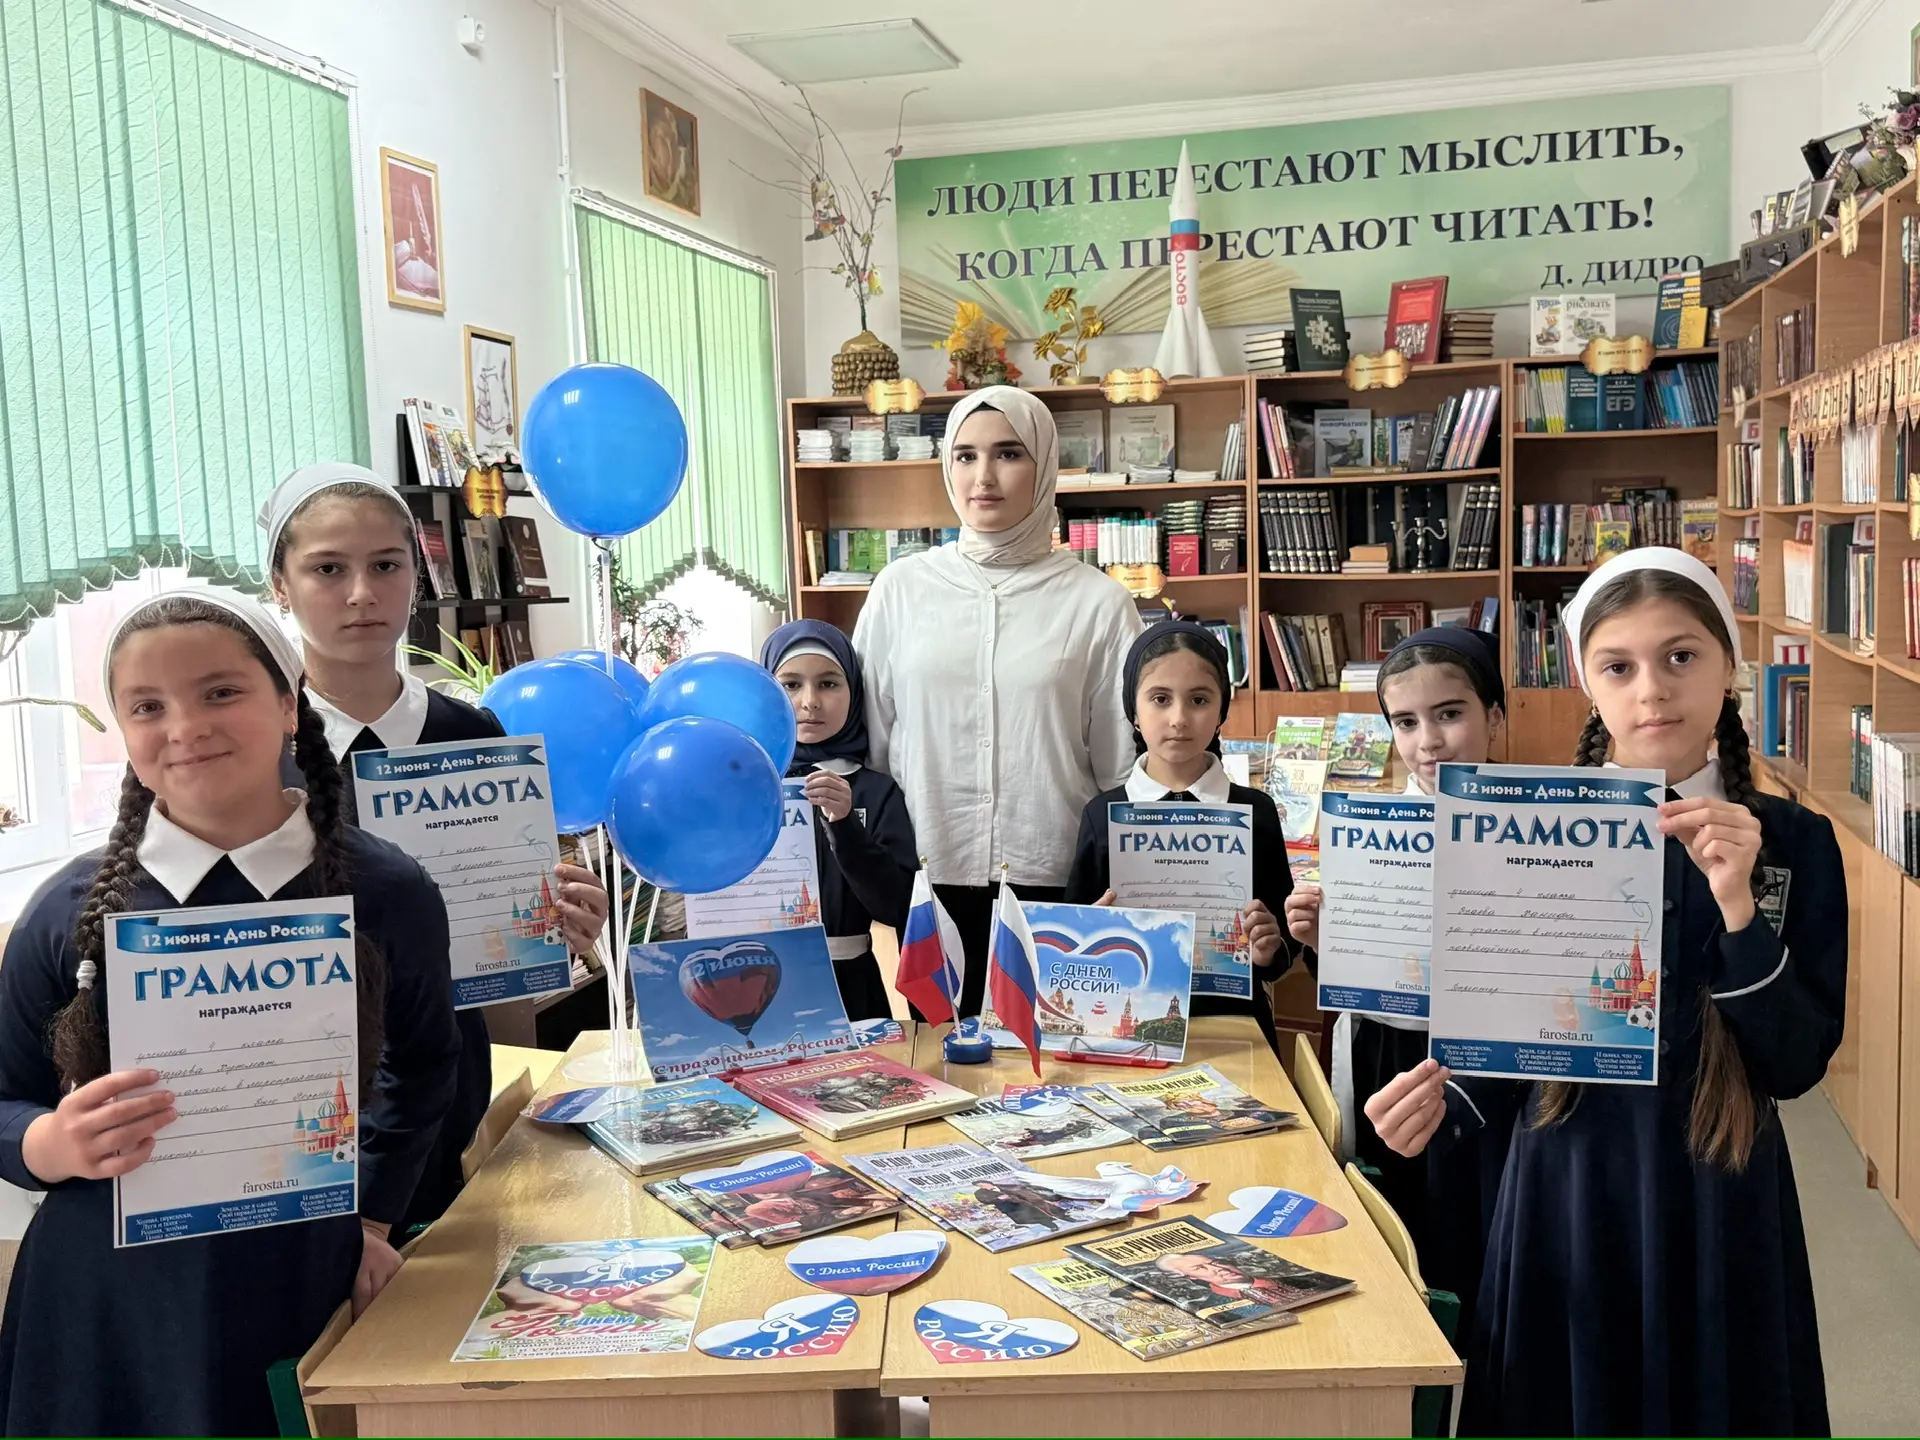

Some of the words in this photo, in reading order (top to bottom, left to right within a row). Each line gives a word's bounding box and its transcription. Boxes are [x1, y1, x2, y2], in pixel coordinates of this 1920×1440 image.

[927, 176, 1074, 217] ЛЮДИ
[1398, 124, 1684, 176] МЫСЛИТЬ,
[955, 241, 1109, 283] КОГДА
[1430, 196, 1654, 244] ЧИТАТЬ!
[1540, 264, 1573, 290] Д.
[375, 764, 391, 776] 12
[394, 761, 430, 774] июня
[441, 757, 474, 772] День
[477, 753, 518, 766] России
[372, 774, 545, 819] ГРАМОТА
[1461, 782, 1478, 794] 12
[1481, 784, 1522, 796] июня
[1535, 785, 1575, 800] День
[1579, 786, 1630, 800] России
[425, 814, 499, 830] награждается
[1123, 813, 1135, 821] 12
[1137, 813, 1163, 821] июня
[1170, 813, 1195, 823] День
[1198, 813, 1230, 823] России
[1336, 804, 1349, 813] 12
[1351, 805, 1380, 815] июня
[1388, 807, 1417, 818] День
[1331, 825, 1435, 853] ГРАМО
[1451, 812, 1655, 850] ГРАМОТА
[1119, 832, 1246, 855] ГРАМОТА
[1154, 858, 1209, 866] награждается
[1369, 858, 1431, 868] награждается
[1506, 856, 1593, 868] награждается
[142, 933, 162, 947] 12
[165, 933, 210, 946] июня
[224, 928, 267, 945] День
[271, 922, 325, 938] России
[134, 952, 353, 1001] ГРАМОТА
[475, 957, 521, 973] farosta.ru
[1050, 962, 1062, 976] С
[1064, 963, 1112, 980] ДНЕМ
[1050, 977, 1120, 995] РОССИИ!
[199, 1001, 292, 1019] награждается
[785, 1033, 850, 1053] Россия!
[1539, 1028, 1593, 1041] farosta.ru
[755, 1055, 875, 1085] ПОЛКОВОДЦЫ
[243, 1178, 299, 1194] farosta.ru
[709, 1179, 720, 1190] С
[722, 1174, 756, 1189] Днем
[757, 1159, 805, 1178] России!
[573, 1261, 629, 1284] Я
[805, 1266, 816, 1276] С
[818, 1264, 862, 1276] Днем
[867, 1256, 925, 1274] России!
[534, 1268, 674, 1299] РОССИЮ
[729, 1305, 858, 1359] РОССИЮ
[758, 1312, 820, 1345] Я
[917, 1318, 1053, 1361] РОССИЮ
[955, 1320, 1029, 1348] Я
